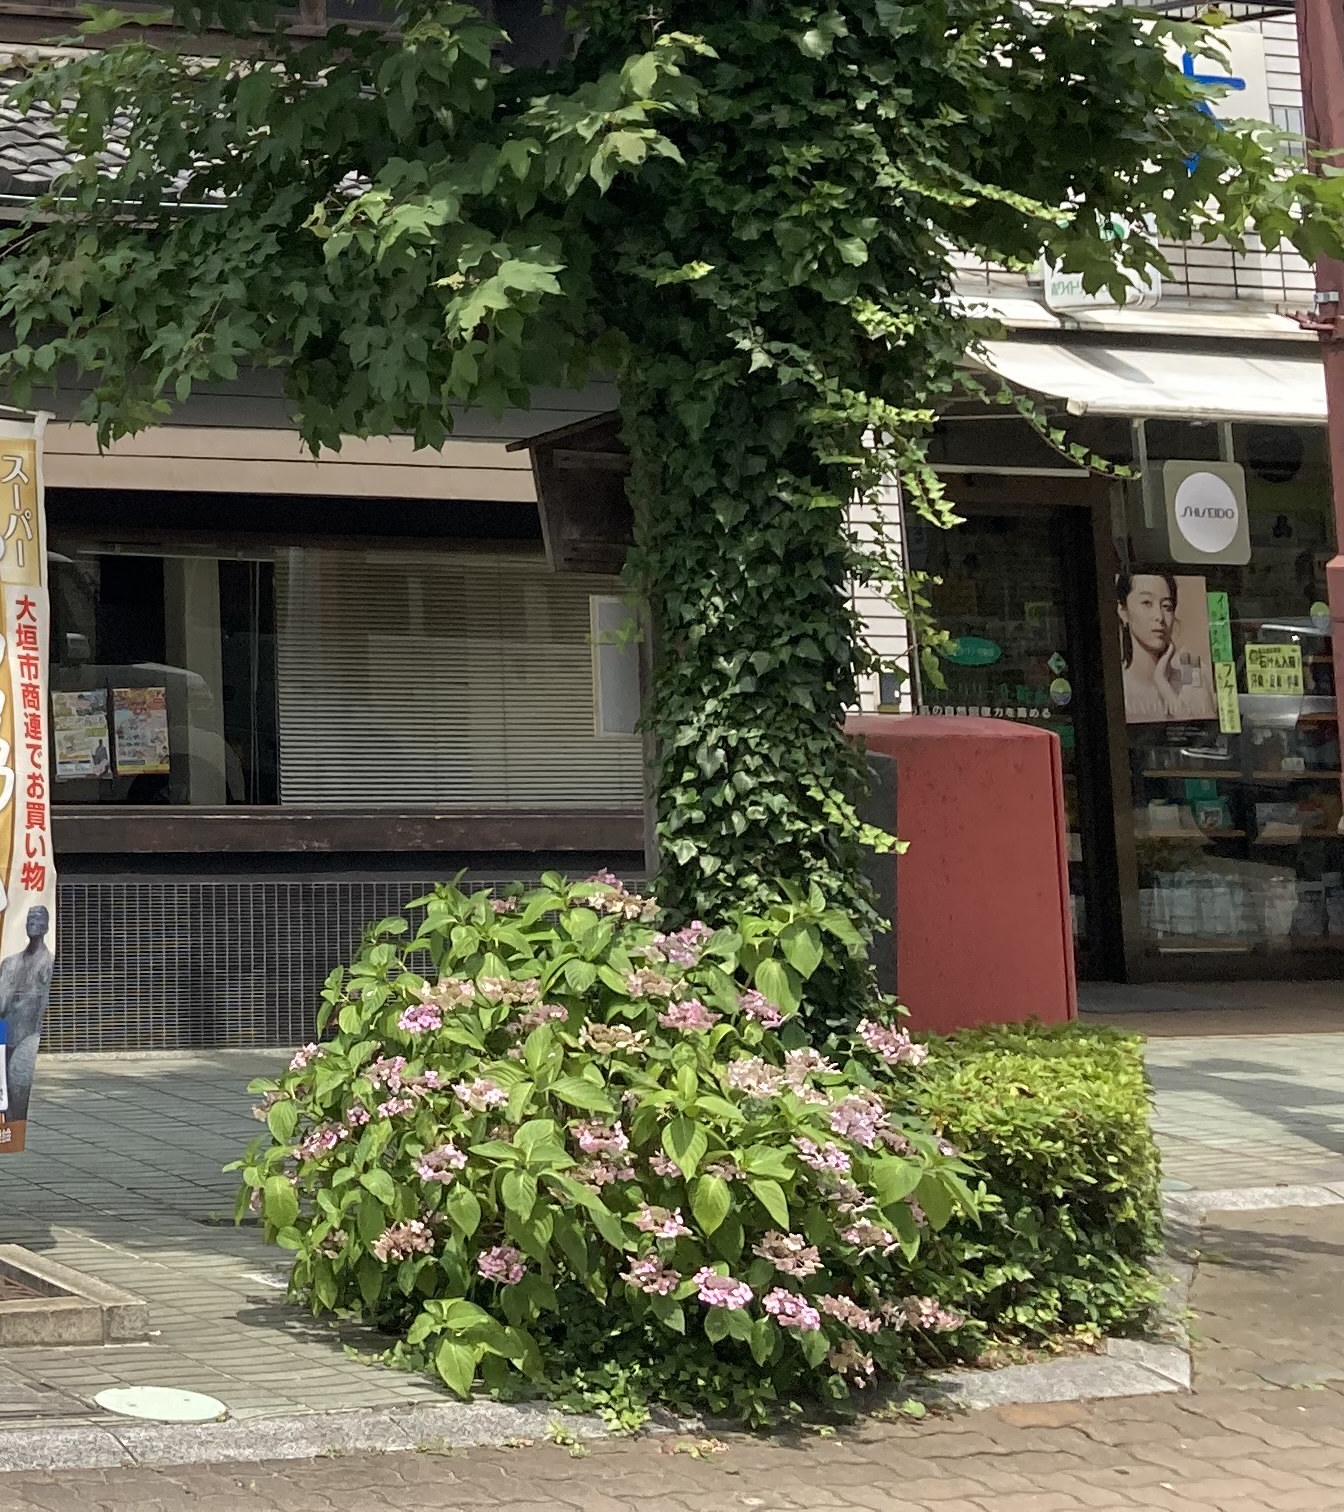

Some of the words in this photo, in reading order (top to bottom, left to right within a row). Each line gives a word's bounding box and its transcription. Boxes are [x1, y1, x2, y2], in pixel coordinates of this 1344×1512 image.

[0, 455, 32, 569] スーパー
[1181, 506, 1235, 519] SHISEIDO
[15, 594, 47, 893] 大垣市商連でお買い物
